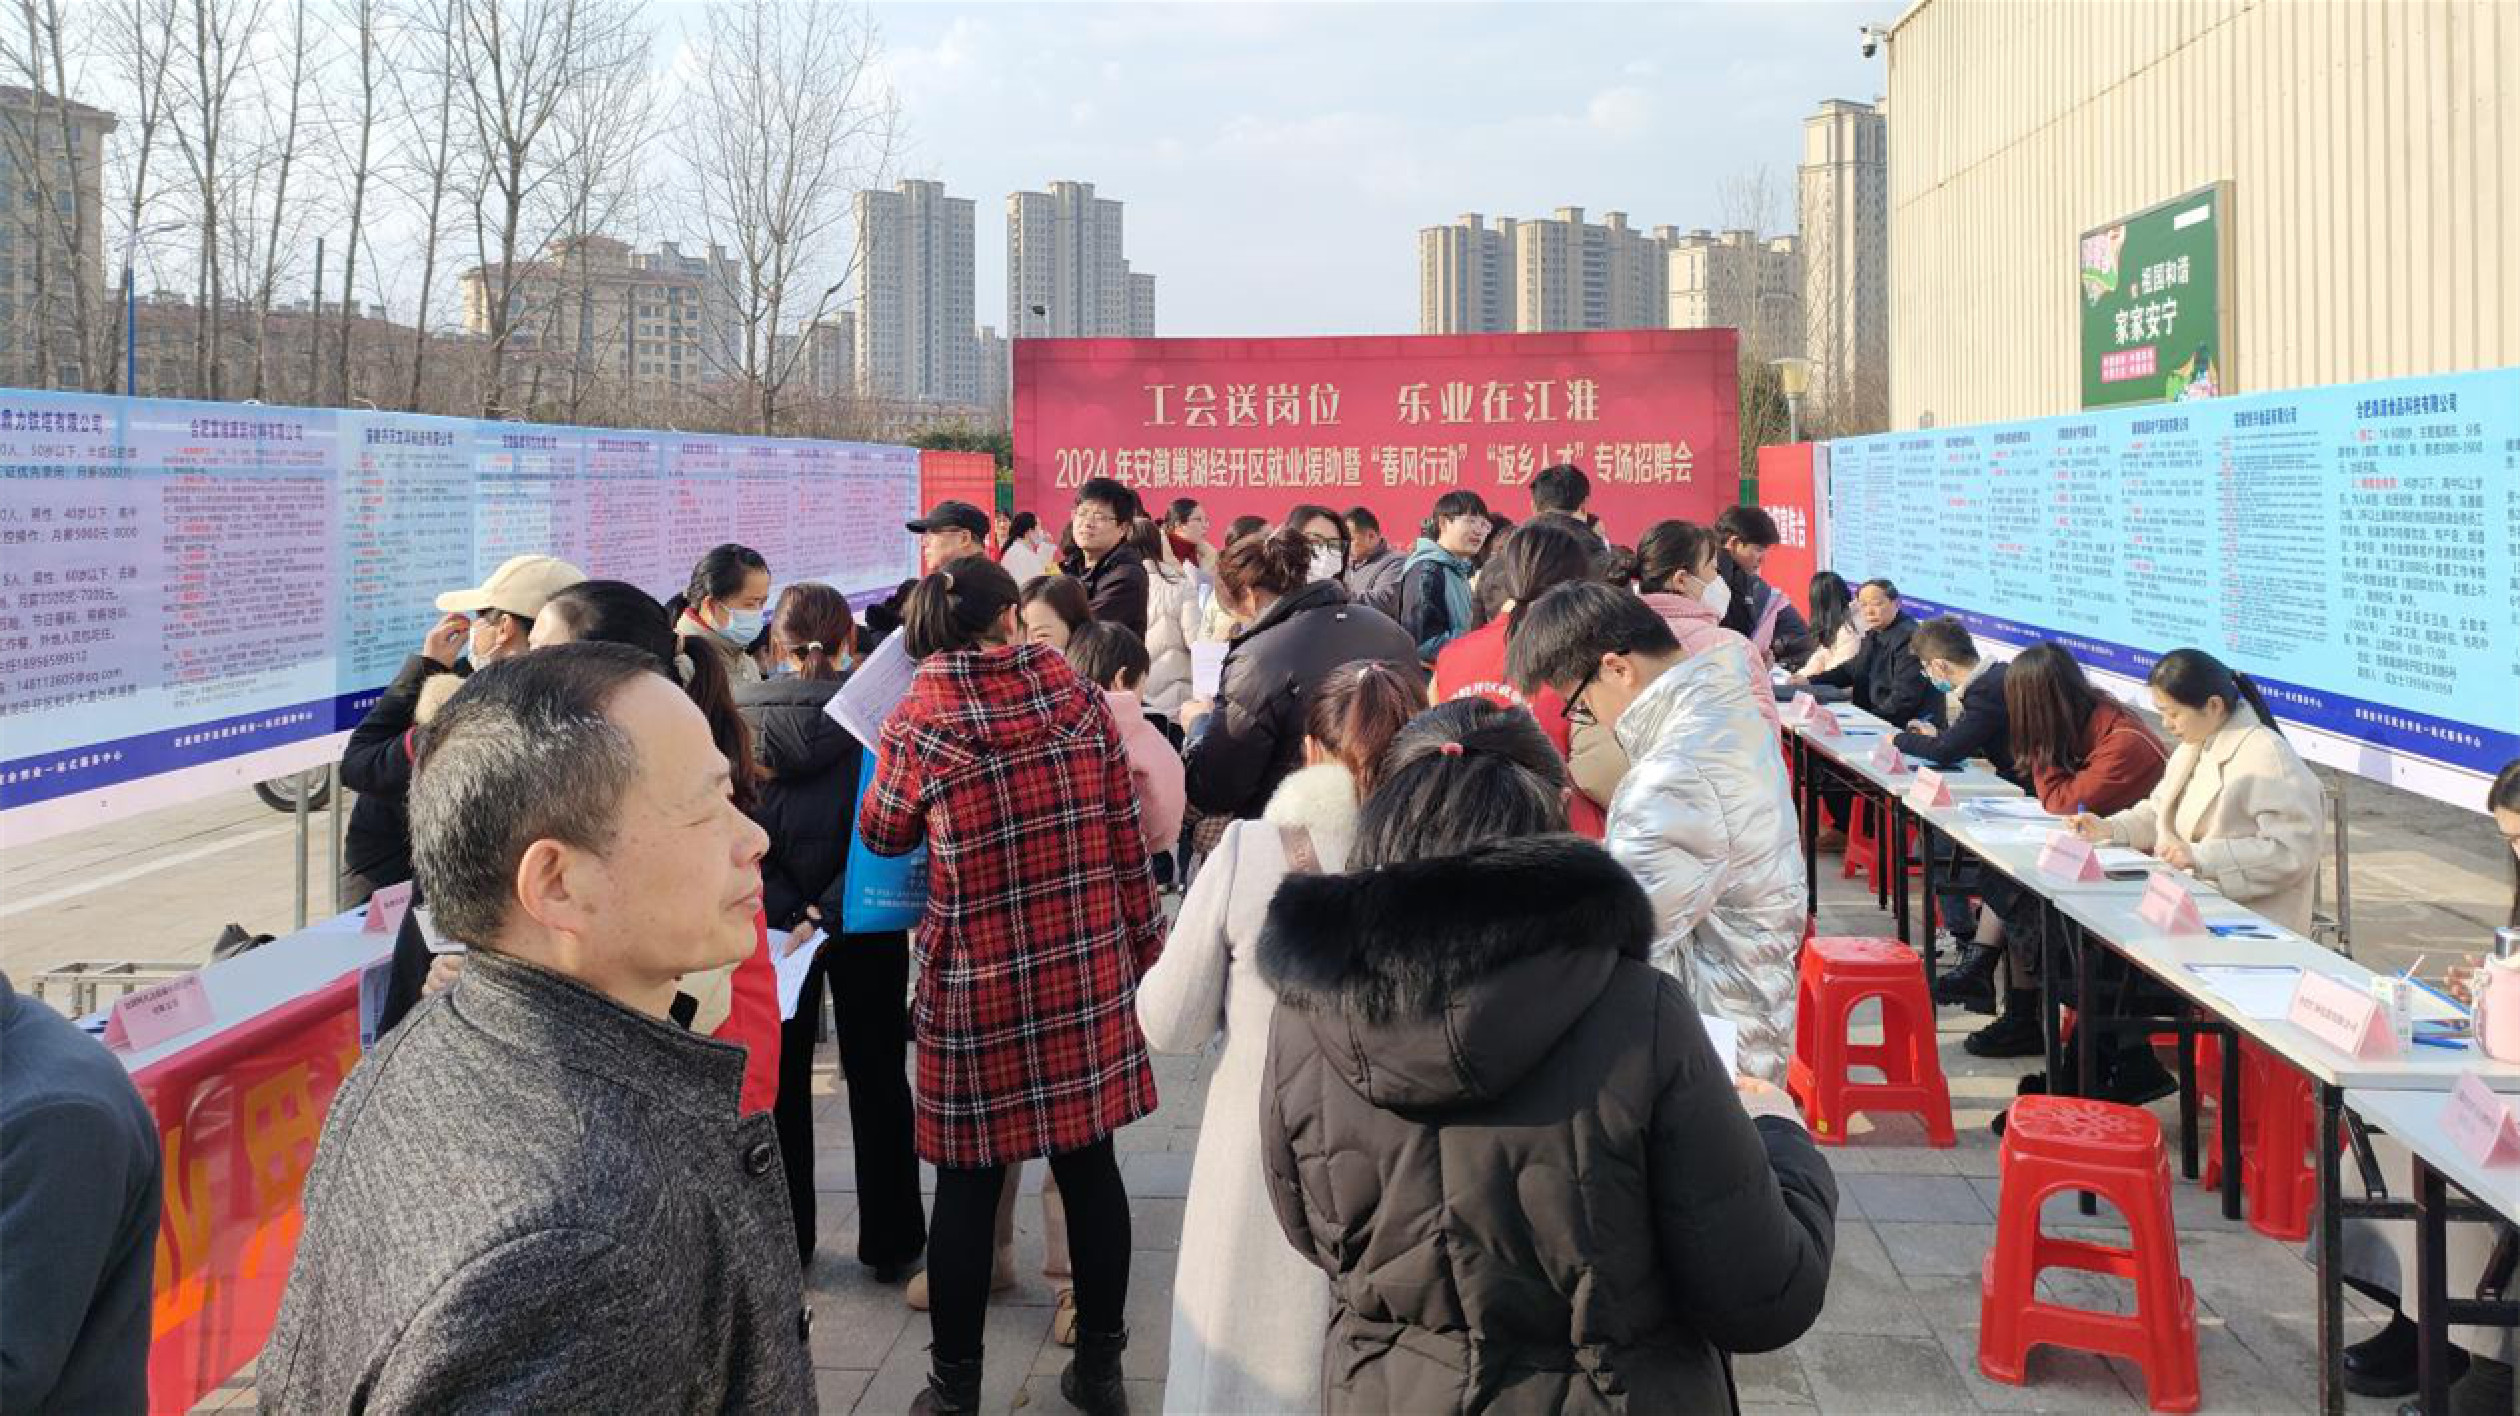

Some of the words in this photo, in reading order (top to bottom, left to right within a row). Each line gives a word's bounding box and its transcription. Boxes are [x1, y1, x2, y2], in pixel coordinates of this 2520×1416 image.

[2115, 296, 2177, 345] 家家安宁
[1143, 382, 1341, 427] 工会送岗位
[1398, 379, 1600, 425] 乐业在江淮
